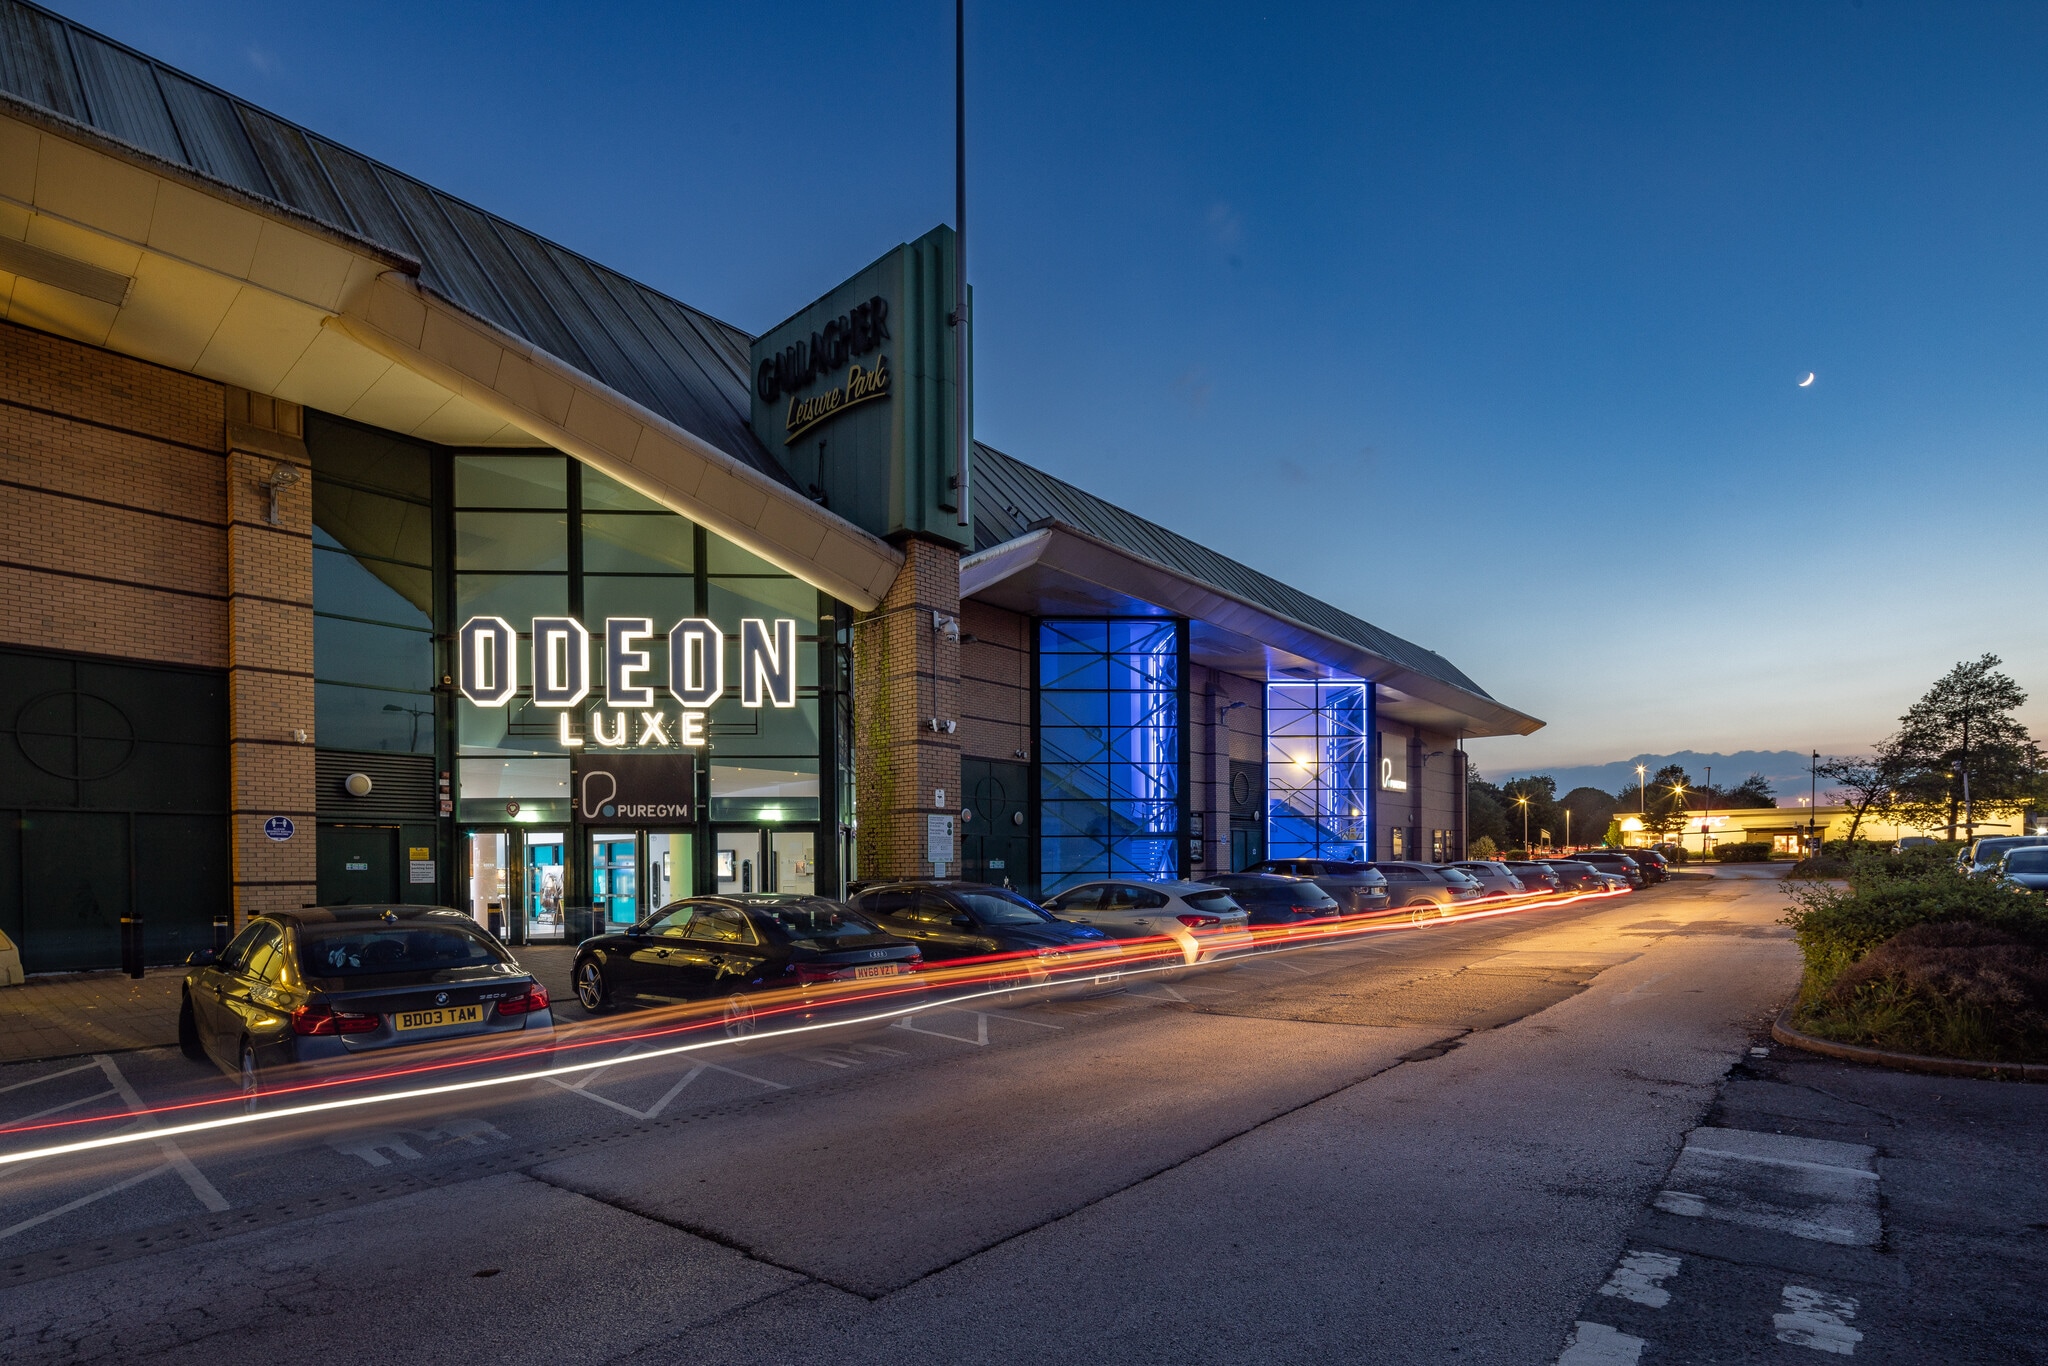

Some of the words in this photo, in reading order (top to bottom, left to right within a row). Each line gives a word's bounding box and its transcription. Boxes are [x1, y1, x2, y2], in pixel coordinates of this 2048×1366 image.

[758, 295, 890, 402] GALLAGHER
[786, 387, 840, 429] Leisure
[845, 354, 886, 402] Park
[459, 616, 796, 708] ODEON
[560, 712, 706, 746] LUXE
[617, 804, 688, 817] PUREGYM
[403, 1012, 442, 1027] BD03
[448, 1008, 476, 1022] TAM
